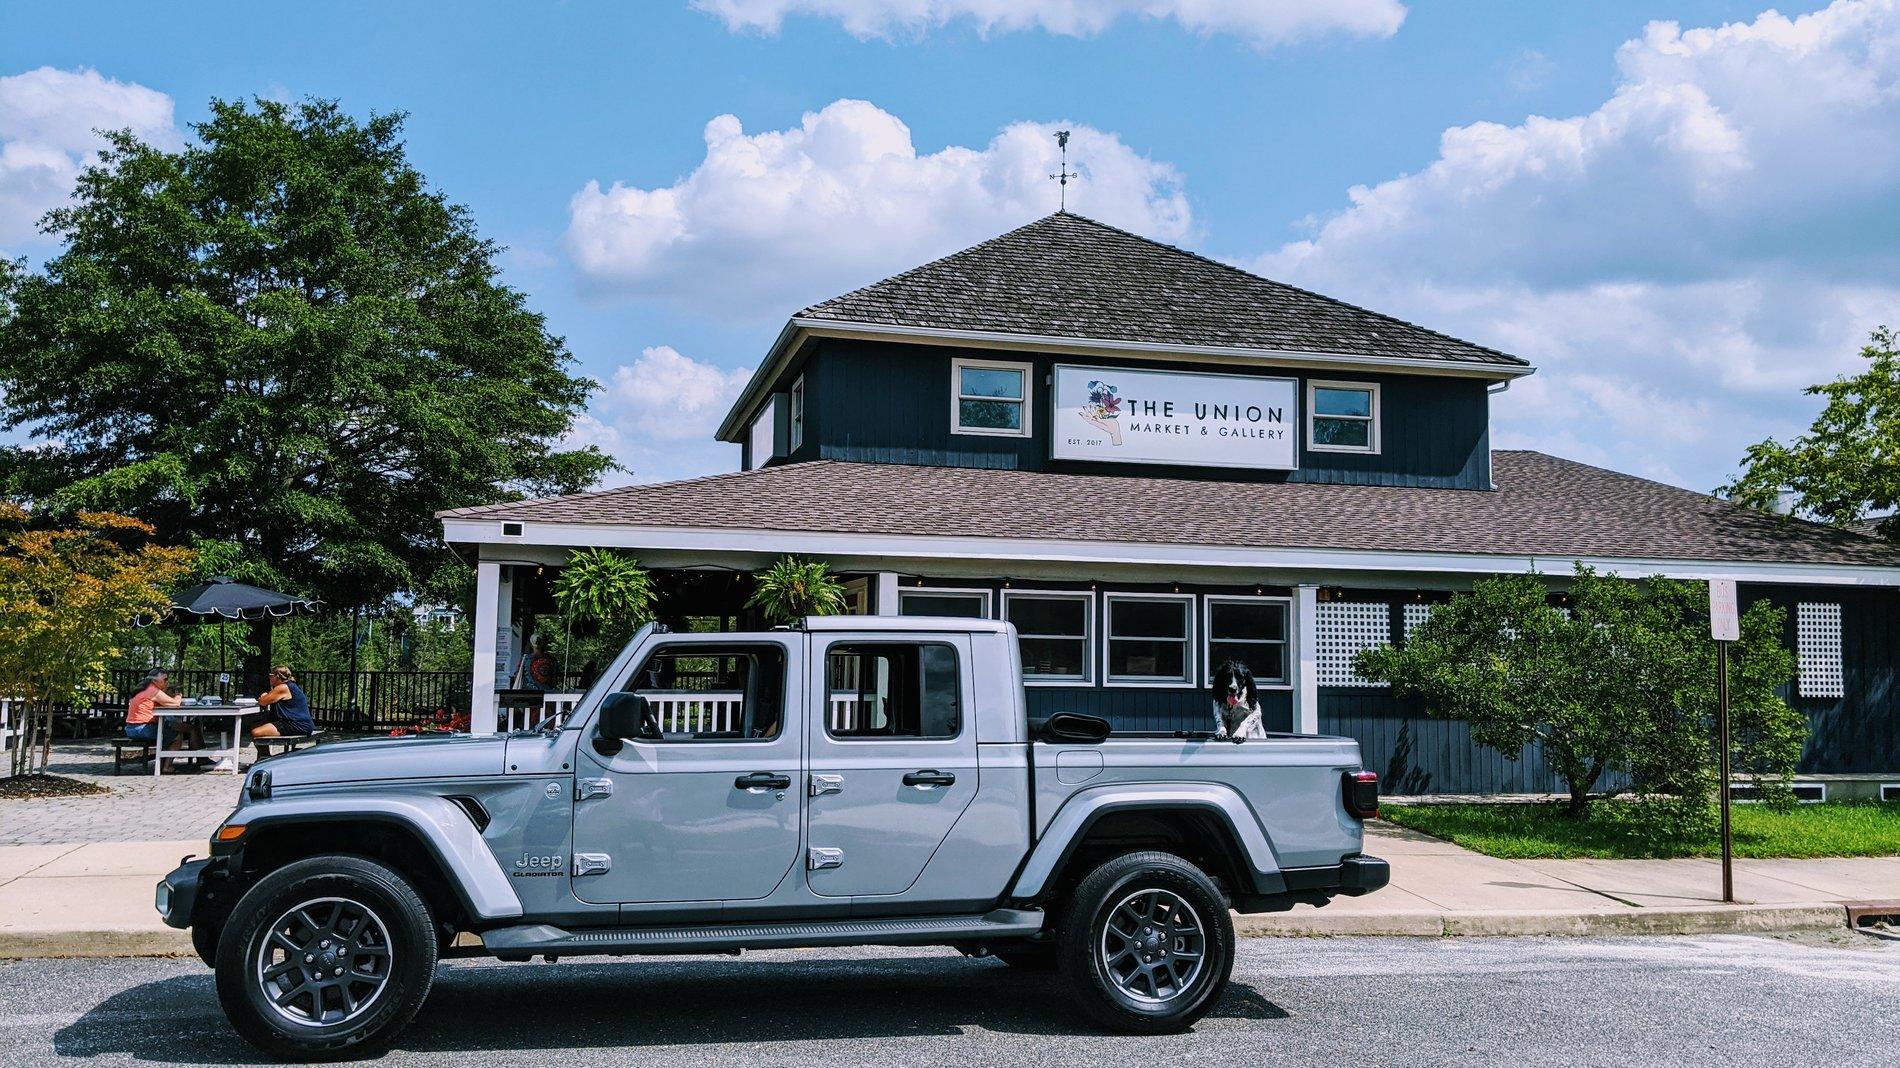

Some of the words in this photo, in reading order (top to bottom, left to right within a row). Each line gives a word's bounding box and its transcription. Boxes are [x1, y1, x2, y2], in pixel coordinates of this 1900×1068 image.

[1127, 399, 1174, 417] THE
[1194, 402, 1282, 422] UNION
[1130, 423, 1190, 435] MARKET
[1200, 426, 1209, 435] &
[1219, 427, 1285, 440] GALLERY
[1067, 438, 1082, 446] EST.
[515, 852, 563, 871] Jeep
